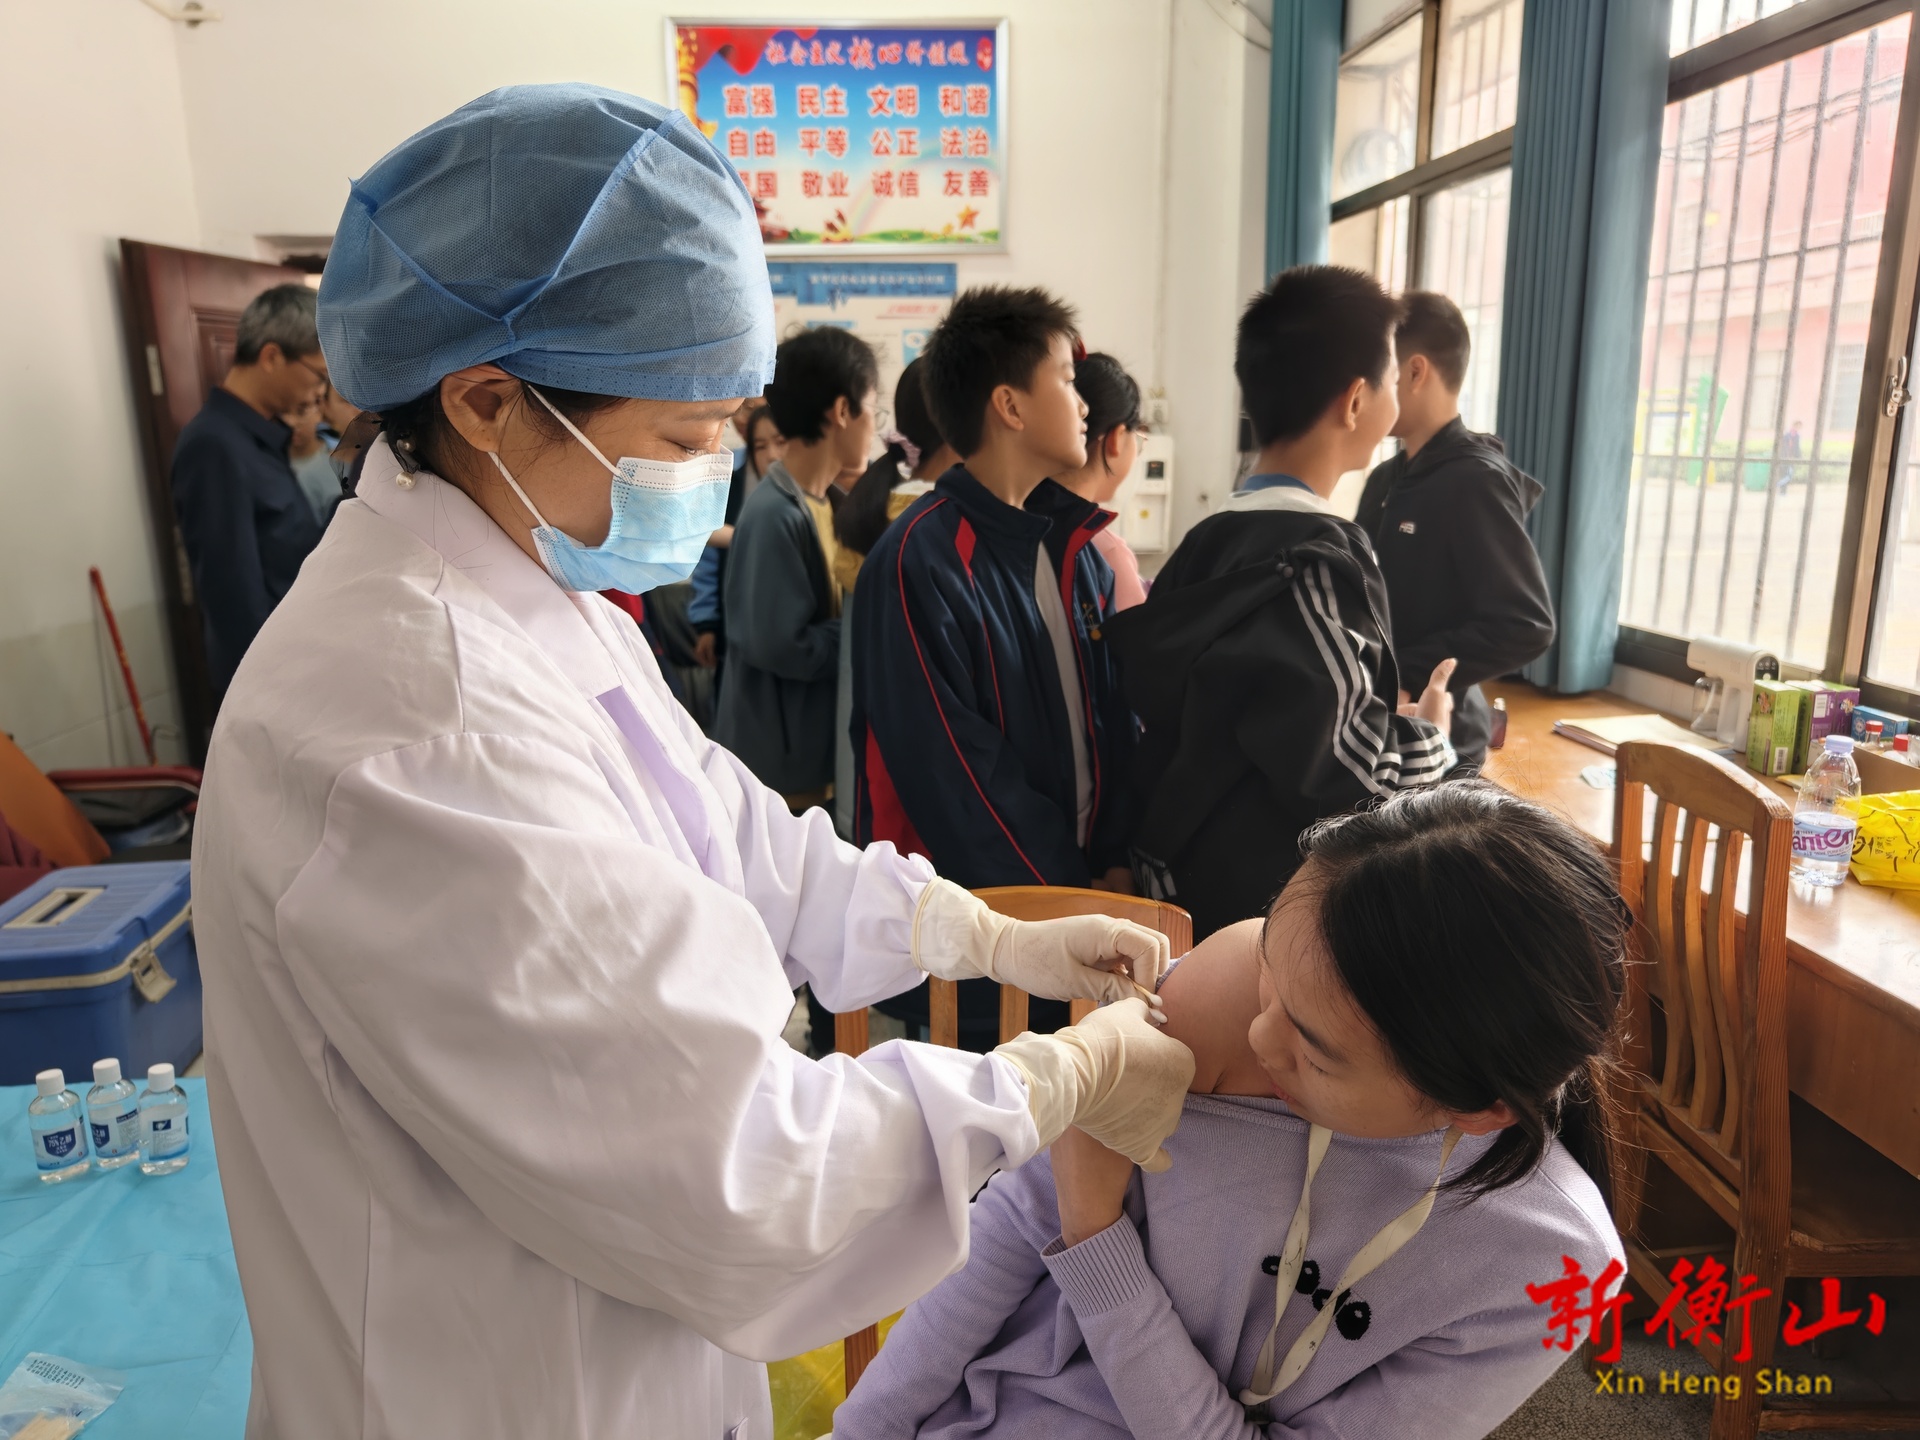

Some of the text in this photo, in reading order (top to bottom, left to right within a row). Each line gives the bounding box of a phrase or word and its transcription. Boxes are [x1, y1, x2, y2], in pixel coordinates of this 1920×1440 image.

[723, 85, 990, 117] 富强 民主 文明 和谐
[727, 128, 990, 158] 自由 平等 公正 法治
[801, 170, 849, 198] 敬业
[872, 170, 920, 198] 诚信
[942, 169, 990, 198] 友善
